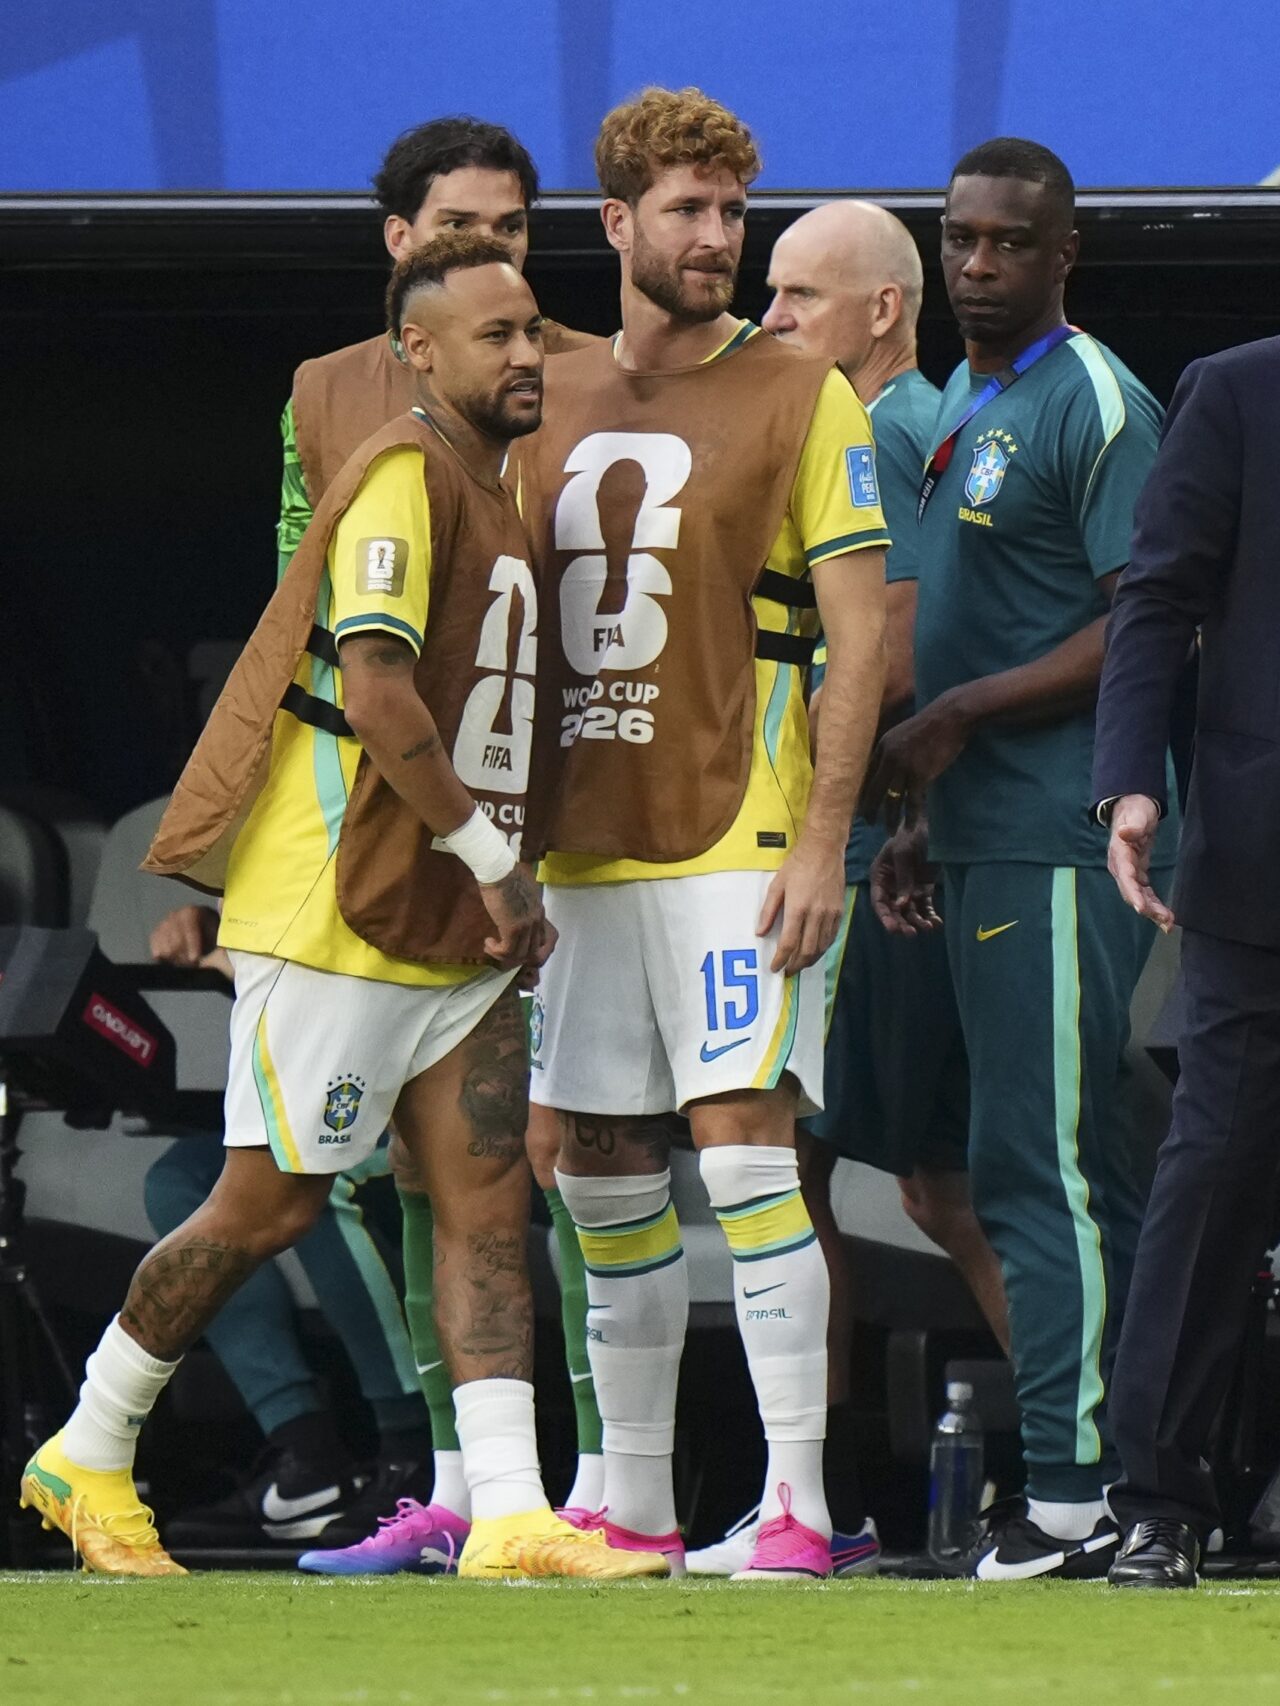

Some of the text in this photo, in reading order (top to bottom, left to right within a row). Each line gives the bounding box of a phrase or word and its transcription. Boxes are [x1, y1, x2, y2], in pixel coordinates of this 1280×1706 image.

[958, 507, 994, 527] BRASIL
[562, 680, 660, 709] WOD CUP
[560, 706, 655, 747] 226
[482, 745, 513, 771] FIFA
[499, 804, 526, 826] CU
[699, 949, 759, 1031] 15
